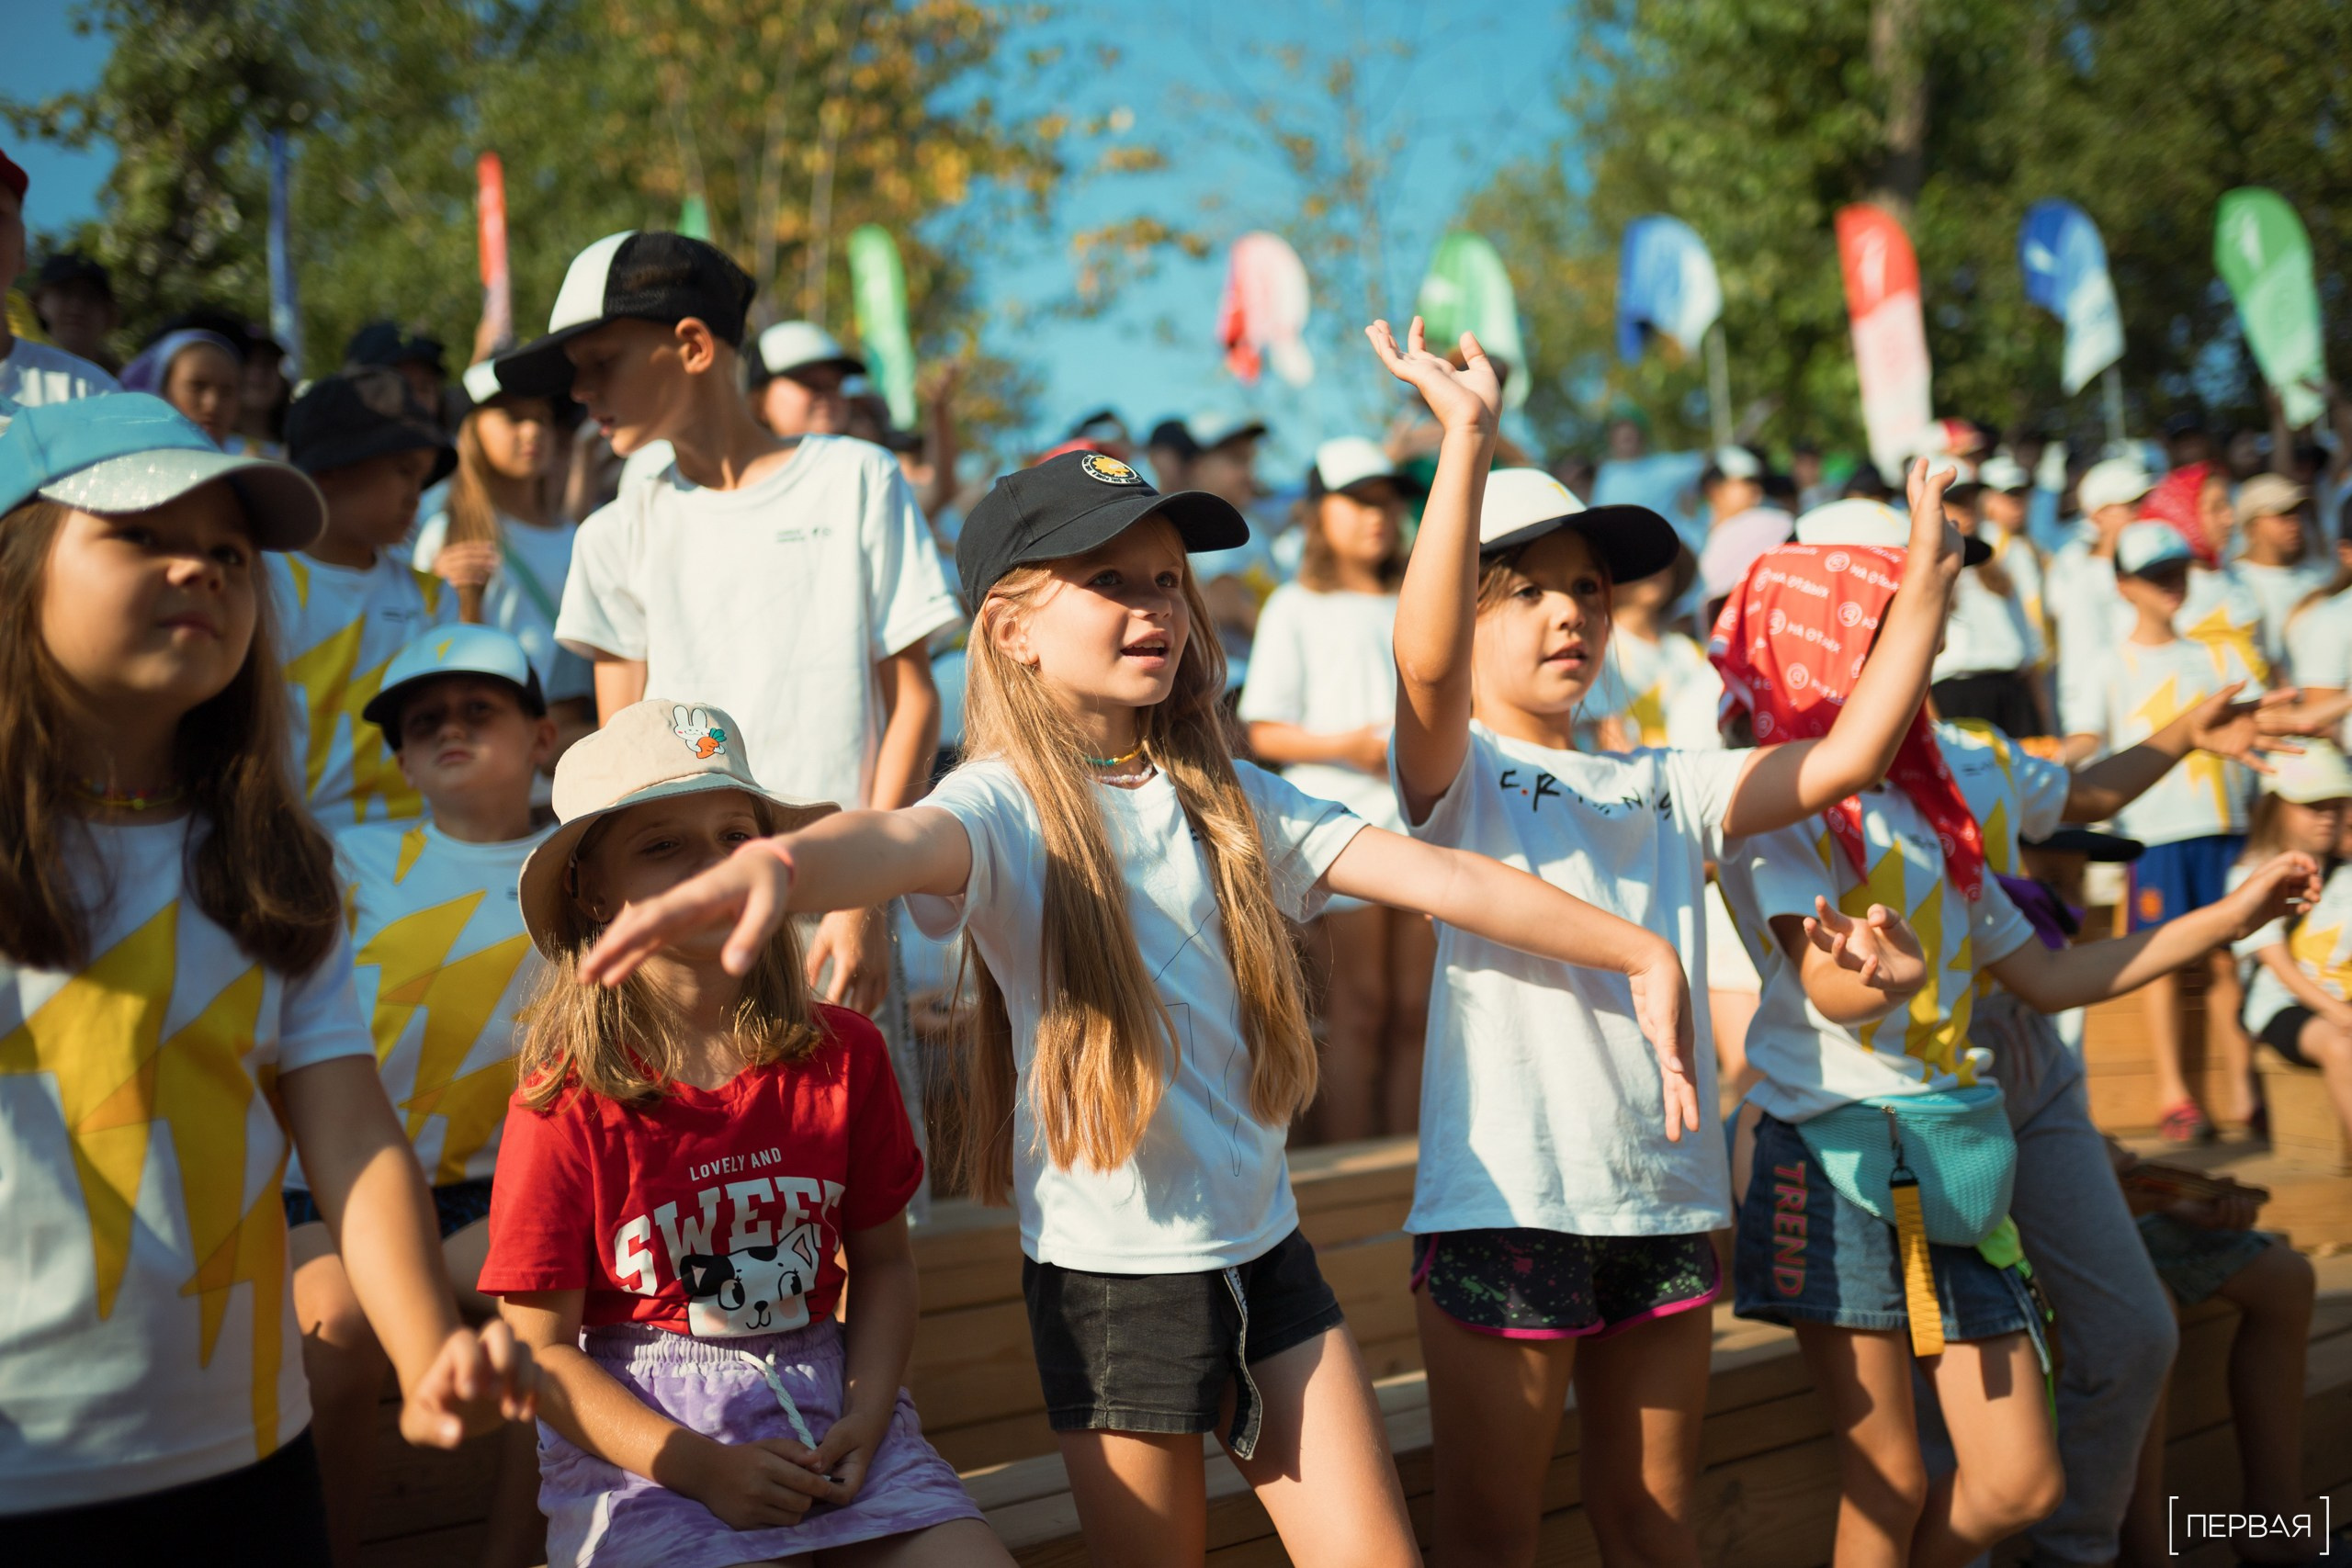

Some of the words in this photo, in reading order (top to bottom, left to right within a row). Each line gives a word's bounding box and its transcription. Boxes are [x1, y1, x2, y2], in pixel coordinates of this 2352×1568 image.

[689, 1154, 745, 1181] LOVELY
[751, 1147, 782, 1168] AND
[1773, 1160, 1808, 1298] TREND
